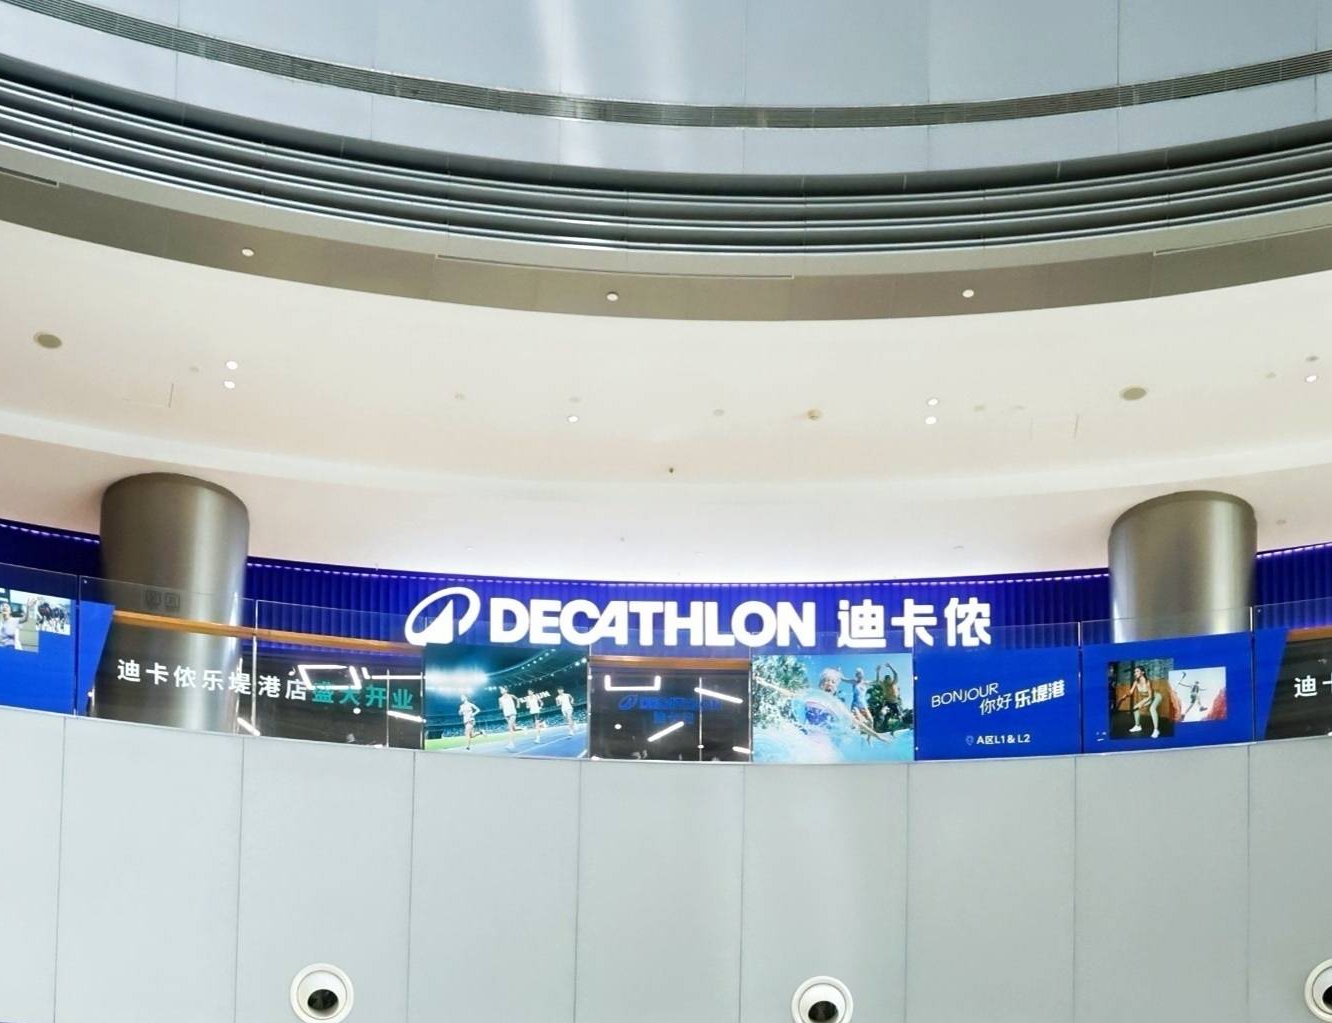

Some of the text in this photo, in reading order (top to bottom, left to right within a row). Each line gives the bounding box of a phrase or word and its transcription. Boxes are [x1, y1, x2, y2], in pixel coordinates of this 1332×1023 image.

[489, 596, 992, 648] DECATHLON 迪卡侬
[931, 682, 998, 709] BONJOUR
[979, 679, 1065, 717] 你好 乐堤港
[1018, 733, 1030, 743] L2
